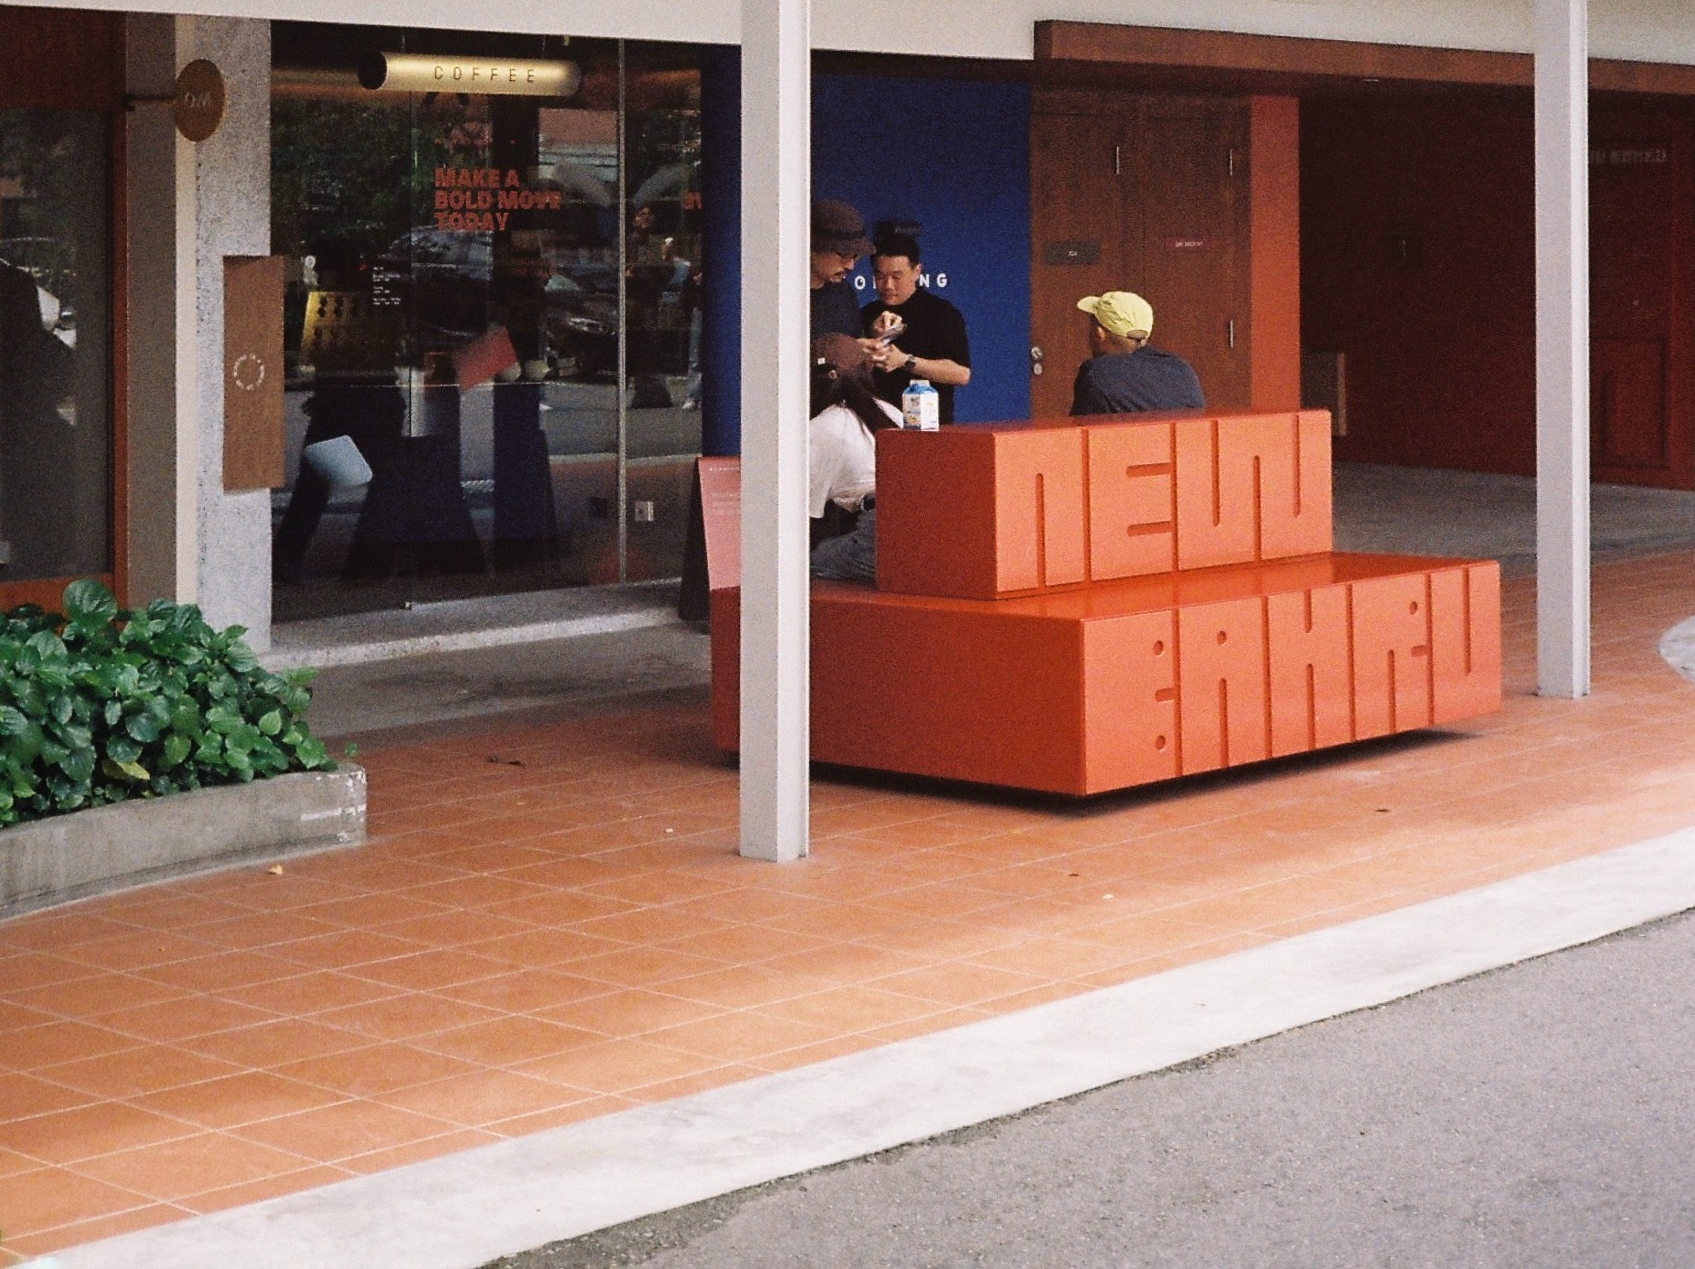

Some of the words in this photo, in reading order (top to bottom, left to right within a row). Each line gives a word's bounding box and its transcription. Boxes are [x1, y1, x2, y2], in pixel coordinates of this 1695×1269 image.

[434, 66, 535, 83] COFFEE
[434, 168, 500, 188] MAKE
[505, 169, 520, 188] A
[434, 190, 494, 210] BOLD
[434, 212, 509, 231] TODAY
